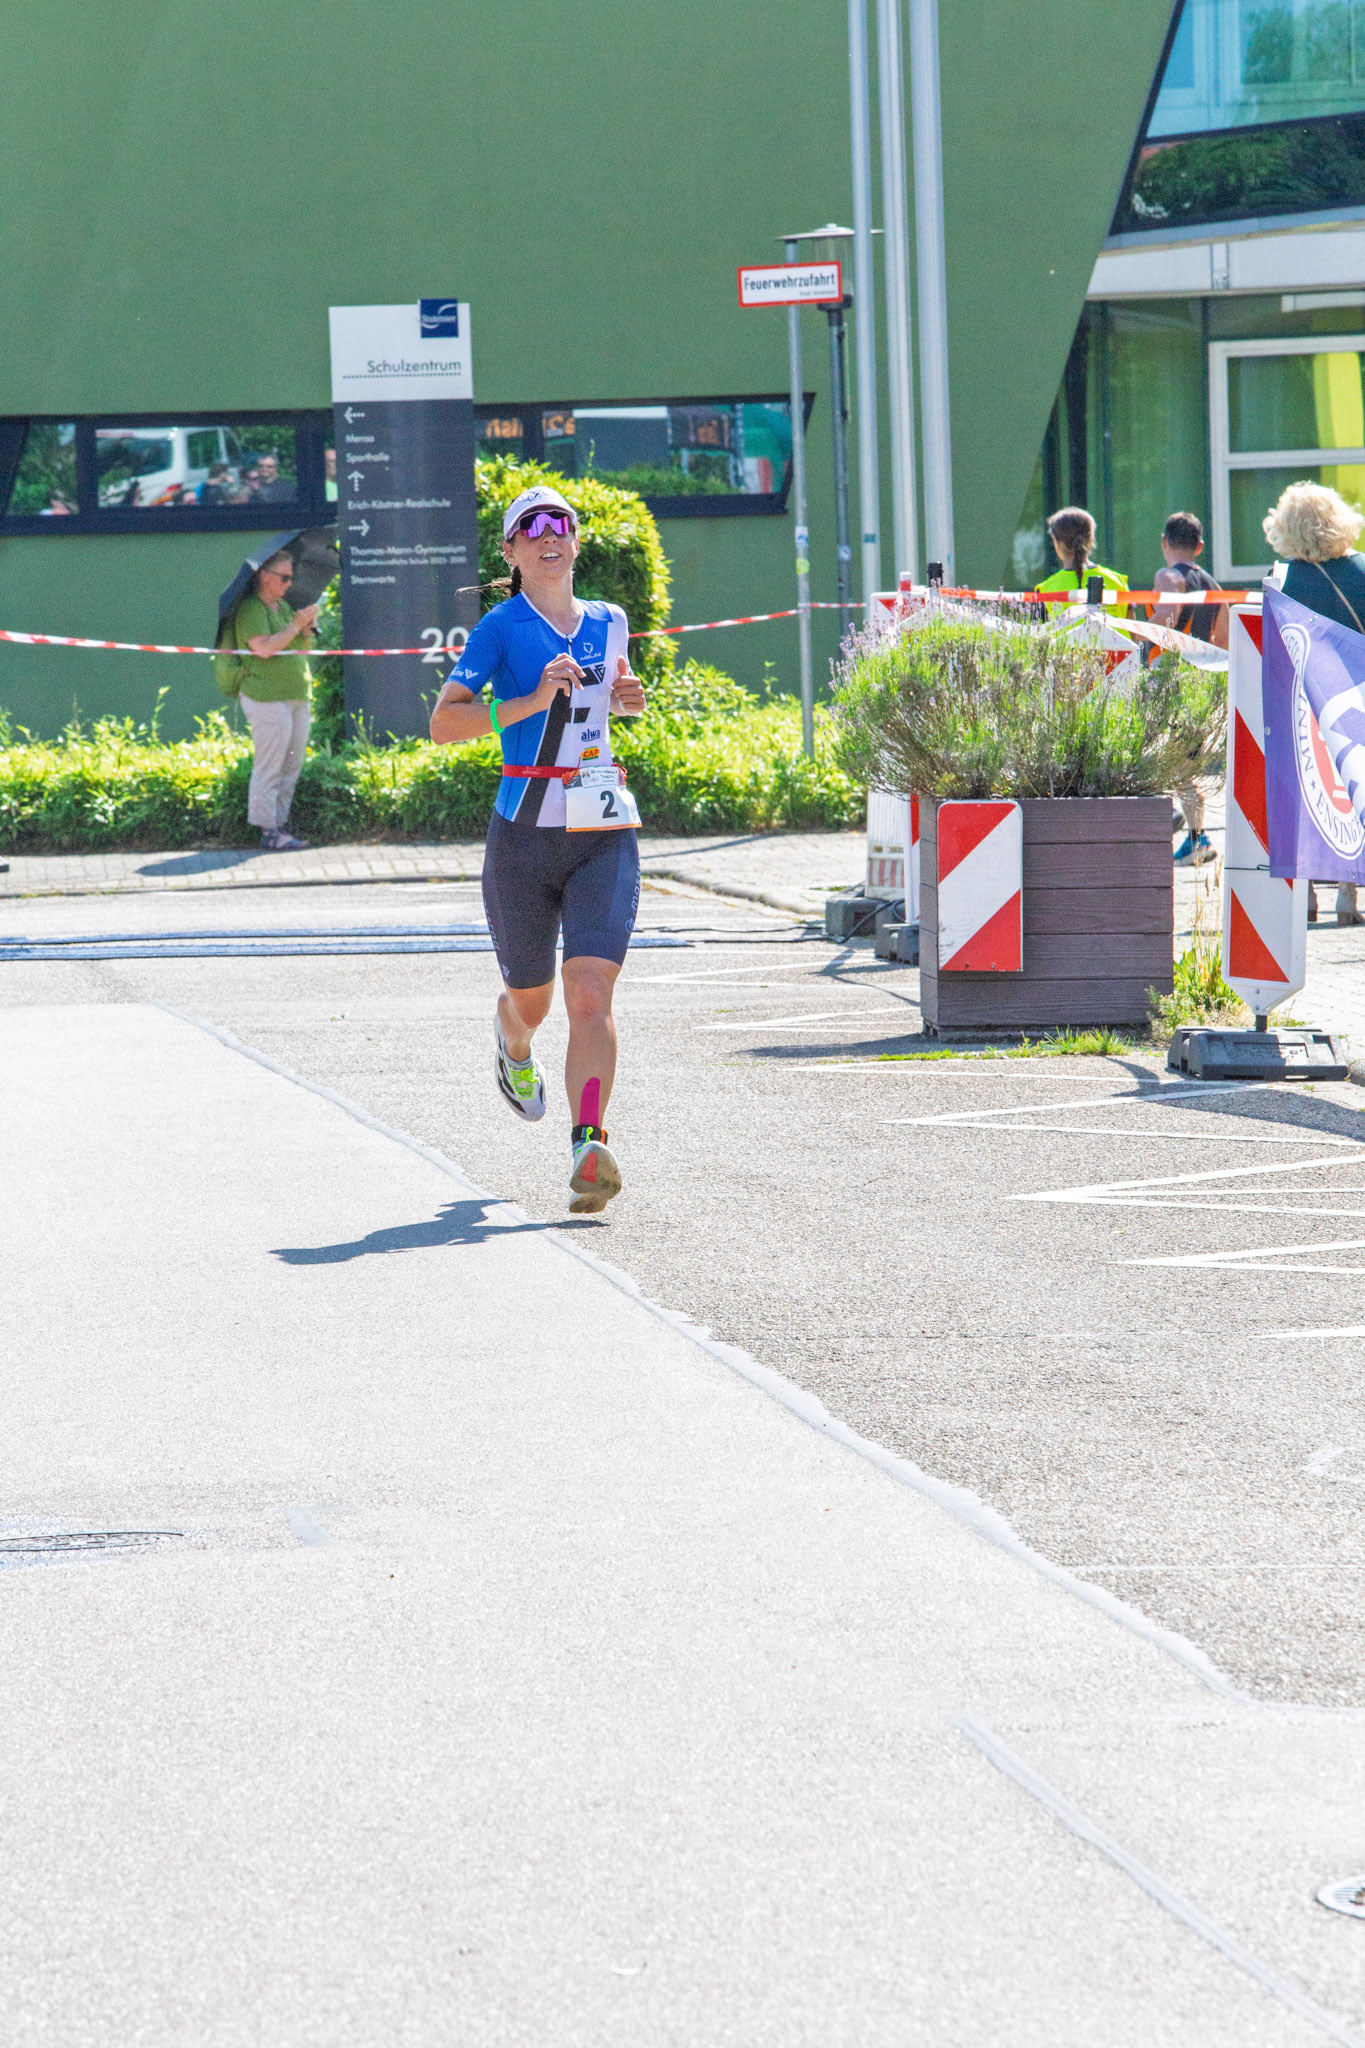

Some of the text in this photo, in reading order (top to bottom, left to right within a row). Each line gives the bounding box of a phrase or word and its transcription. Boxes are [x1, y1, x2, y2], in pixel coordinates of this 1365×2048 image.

[744, 272, 835, 291] Feuerwehrzufahrt
[367, 358, 462, 374] Schulzentrum
[346, 433, 375, 443] Mensa
[347, 452, 390, 464] Sporthalle
[350, 543, 467, 556] Thomas-Mann-Gymnasium
[350, 574, 397, 586] Sternwarte
[581, 729, 601, 740] alwa
[583, 748, 599, 758] CAP
[600, 790, 619, 819] 2
